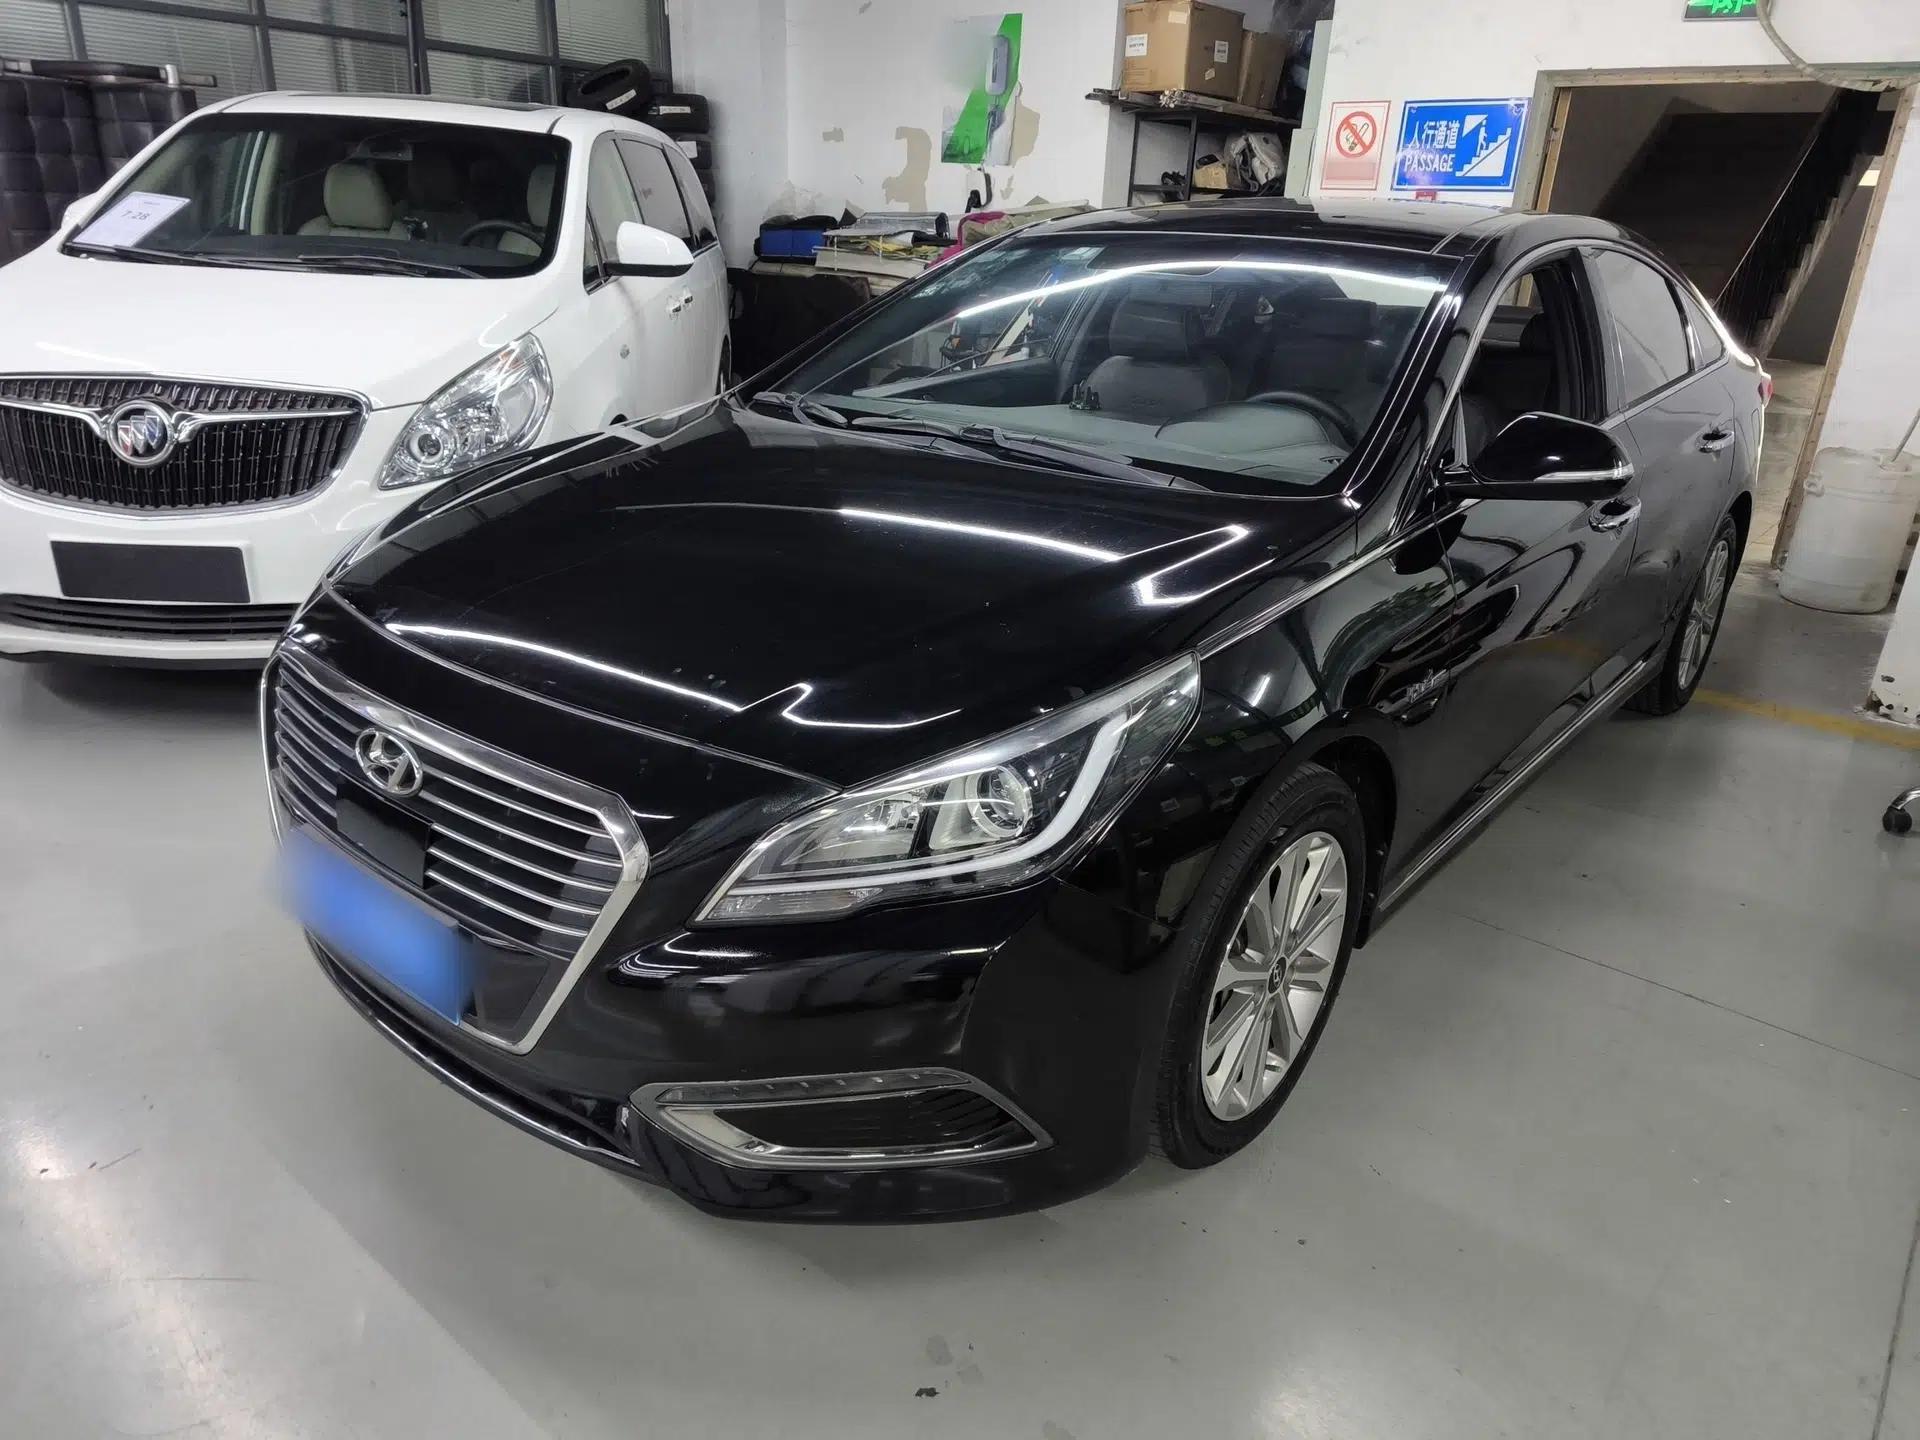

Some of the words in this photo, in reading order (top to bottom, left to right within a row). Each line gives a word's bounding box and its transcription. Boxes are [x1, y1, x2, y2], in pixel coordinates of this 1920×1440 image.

[1409, 119, 1460, 149] 人行通道
[1404, 153, 1456, 172] PASSAGE
